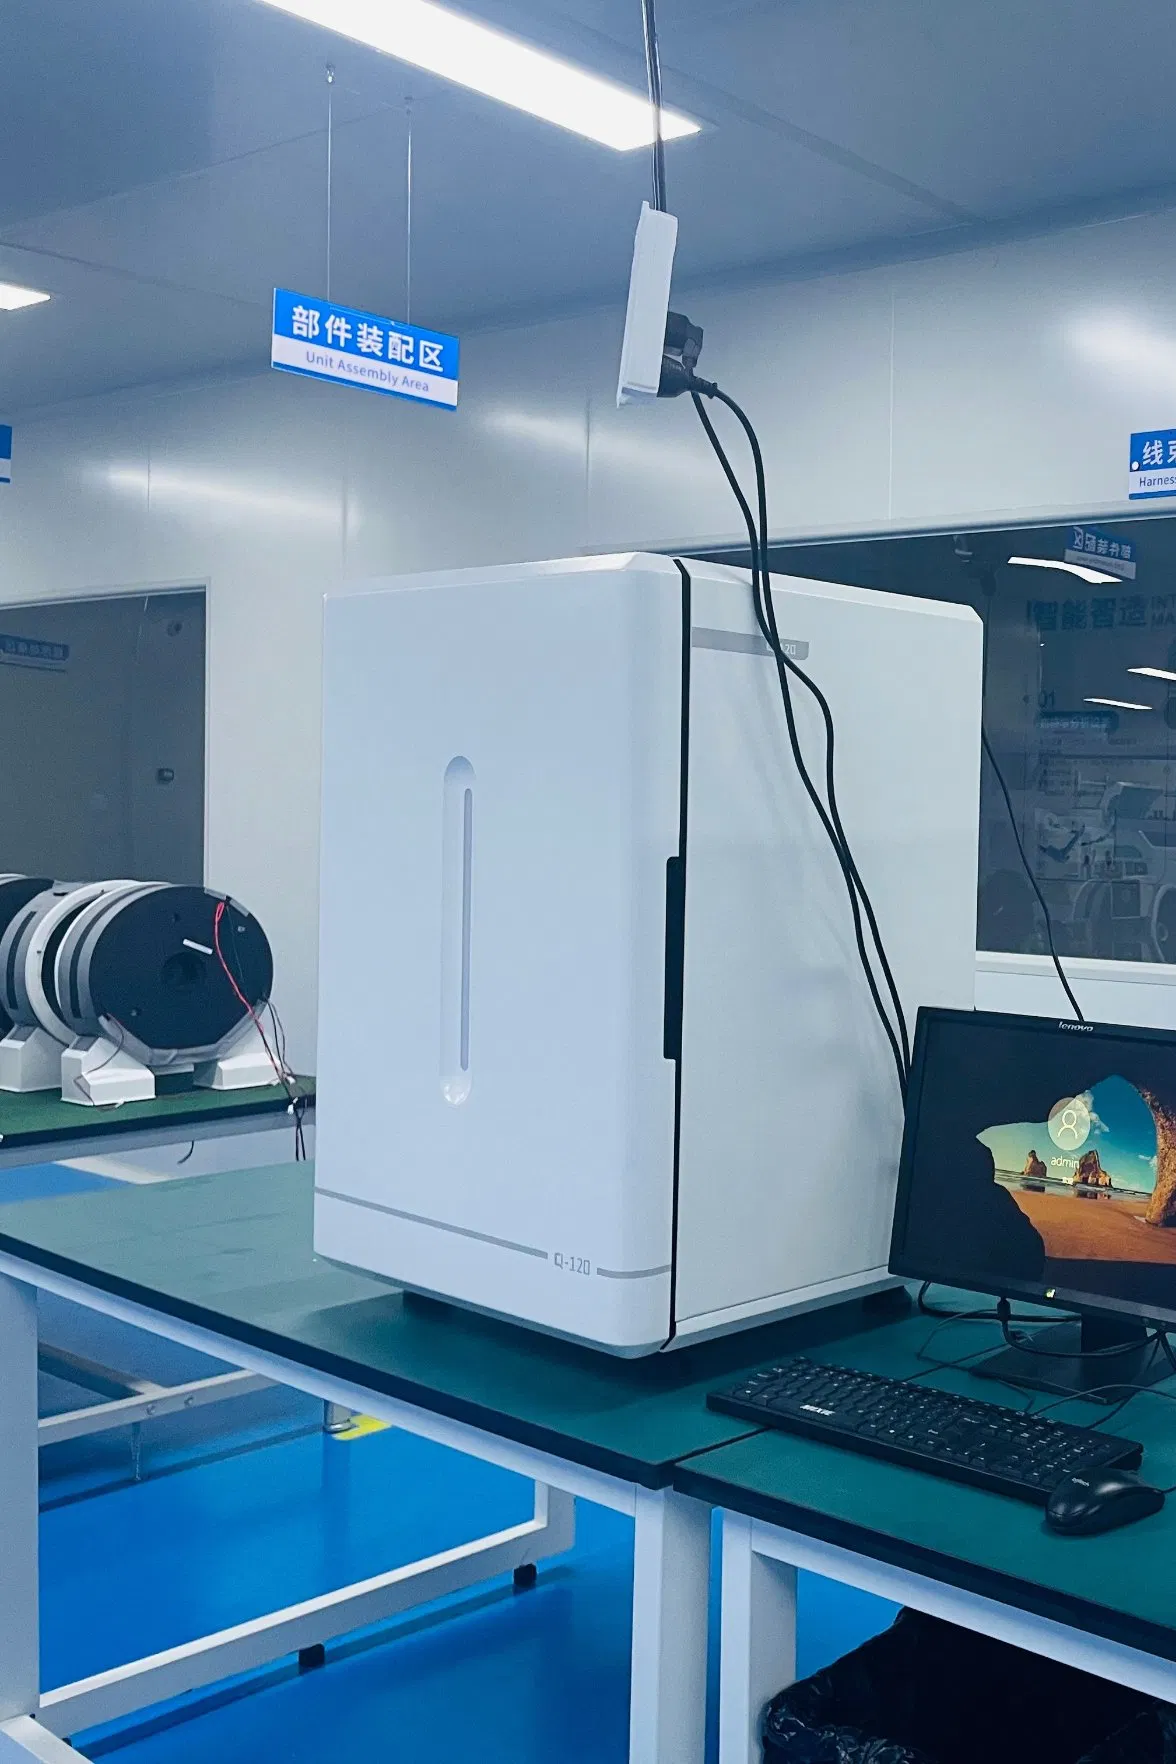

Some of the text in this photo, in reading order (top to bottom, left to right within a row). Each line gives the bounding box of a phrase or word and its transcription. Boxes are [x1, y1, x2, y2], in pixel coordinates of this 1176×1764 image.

[292, 305, 444, 373] 部件装配区
[306, 351, 430, 393] Unit Assembly Area
[1058, 1021, 1094, 1032] lenovo
[1050, 1155, 1080, 1169] admin
